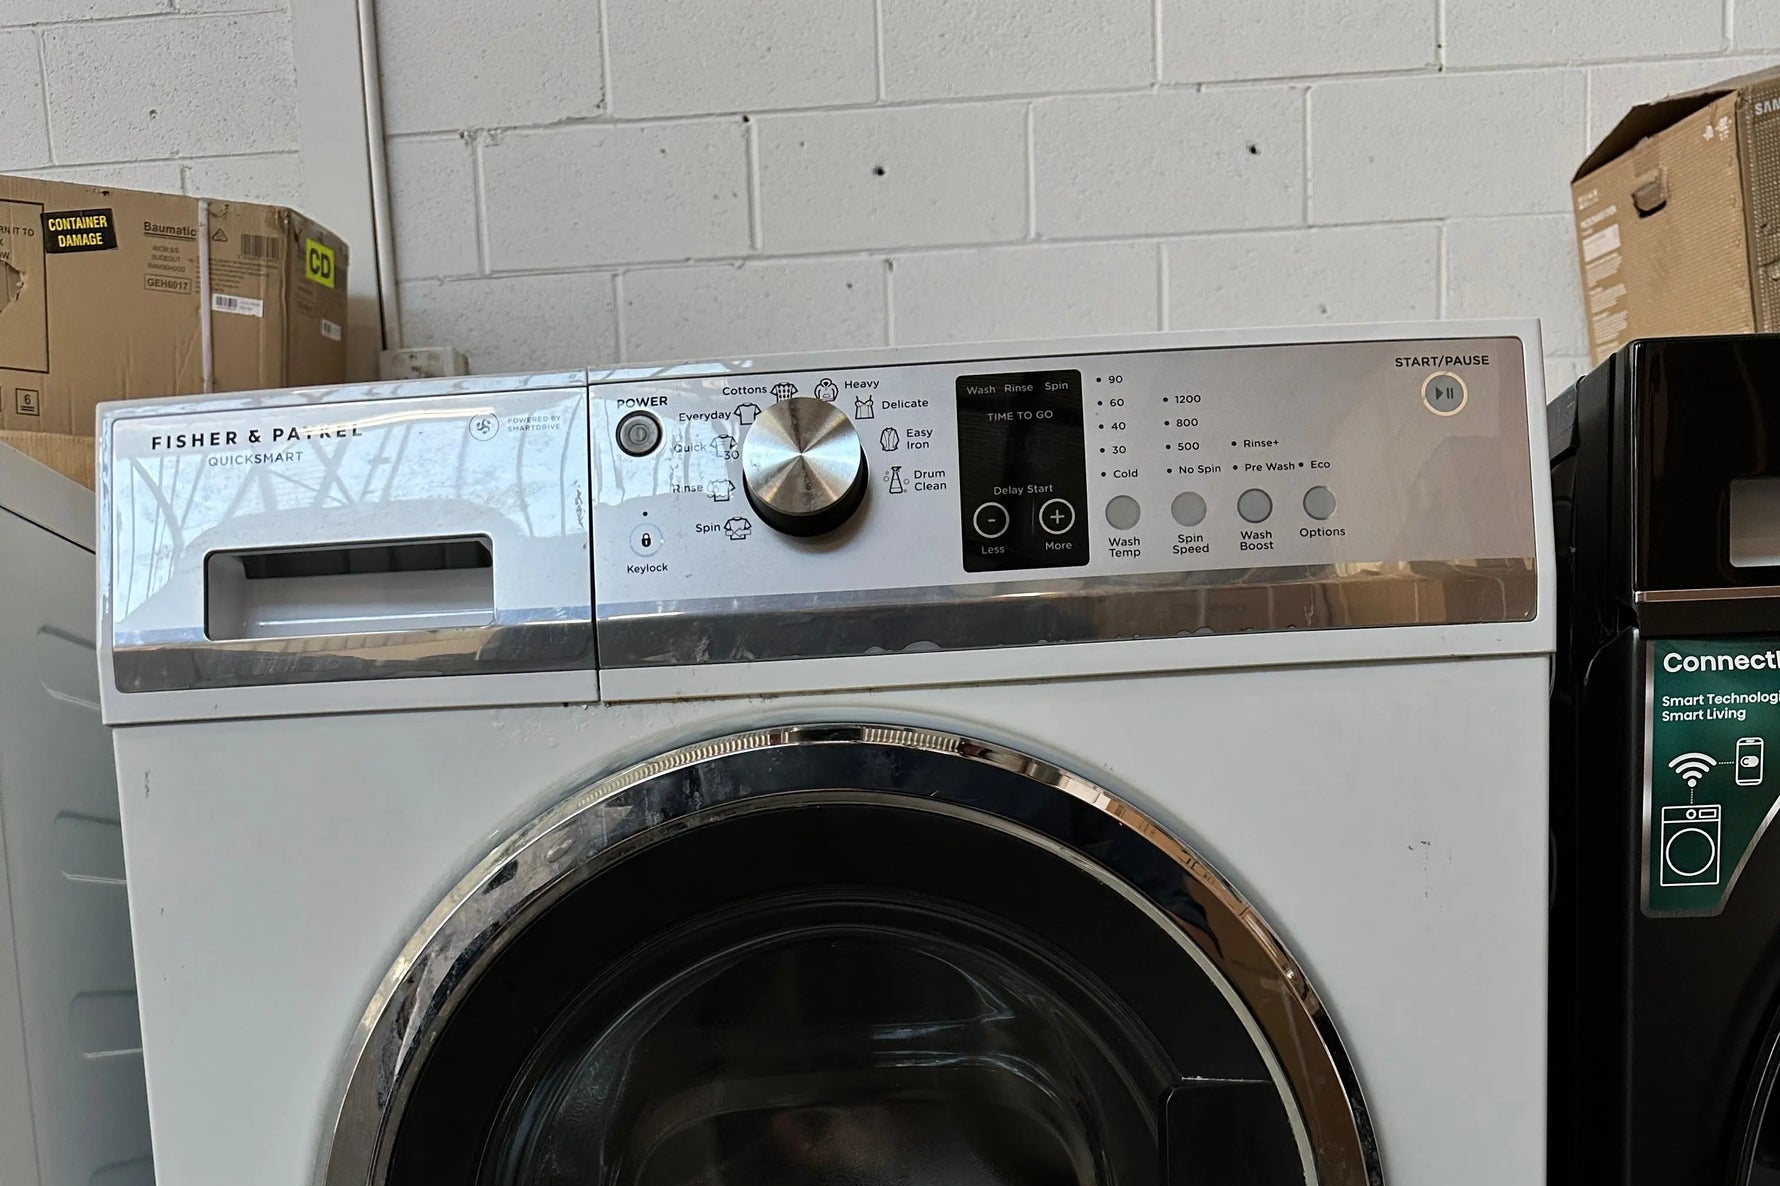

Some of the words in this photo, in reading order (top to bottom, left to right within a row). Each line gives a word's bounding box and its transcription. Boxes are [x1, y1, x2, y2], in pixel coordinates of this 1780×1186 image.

[48, 216, 107, 231] CONTAINER
[144, 222, 196, 236] Baumatic
[13, 227, 20, 235] IT
[22, 228, 34, 236] TO
[58, 233, 103, 247] DAMAGE
[310, 248, 330, 279] CD
[1395, 355, 1489, 368] START/PAUSE
[844, 378, 880, 391] Heavy
[1108, 375, 1123, 384] 90
[722, 384, 767, 396] Cottons
[967, 385, 996, 395] Wash
[1004, 383, 1033, 393] Rinse
[1045, 381, 1068, 392] Spin
[24, 394, 31, 404] 6
[617, 396, 668, 409] POWER
[881, 399, 928, 409] Delicate
[1109, 398, 1124, 407] 60
[1174, 395, 1201, 403] 1200
[679, 410, 731, 423] Everyday
[987, 412, 1013, 421] TIME
[1017, 411, 1032, 420] TO
[1036, 410, 1053, 419] GO
[508, 424, 560, 432] SMARTDRIVE
[1111, 422, 1126, 431] 40
[1176, 418, 1198, 427] 800
[152, 431, 237, 449] FISHER
[249, 430, 260, 443] &
[273, 424, 363, 444] PAEL
[906, 428, 933, 441] Easy
[906, 438, 930, 450] Iron
[1177, 442, 1199, 451] 500
[1243, 438, 1279, 448] Rinse+
[674, 441, 706, 454] Quick
[724, 449, 739, 460] 30
[1112, 445, 1127, 454] 30
[209, 452, 303, 466] QUICKSMART
[1310, 460, 1330, 469] Eco
[1179, 465, 1194, 474] No
[1197, 464, 1221, 474] Spin
[1244, 462, 1262, 472] Pre
[1266, 461, 1295, 471] Wash
[914, 469, 945, 479] Drum
[1113, 469, 1138, 478] Cold
[673, 482, 703, 493] Rinse
[914, 481, 947, 491] Clean
[993, 485, 1024, 496] Delay
[1027, 484, 1053, 493] Start
[696, 522, 721, 534] Spin
[1299, 527, 1346, 538] Options
[1177, 533, 1203, 544] Spin
[1240, 530, 1272, 540] Wash
[1045, 541, 1072, 550] More
[1108, 537, 1141, 547] Wash
[1240, 541, 1273, 551] Boost
[981, 545, 1004, 554] Less
[1109, 547, 1141, 558] Temp
[1172, 544, 1210, 555] Speed
[627, 562, 668, 574] Keylock
[1662, 695, 1704, 707] Smart
[1662, 710, 1704, 722] Smart
[1707, 708, 1746, 721] Living
